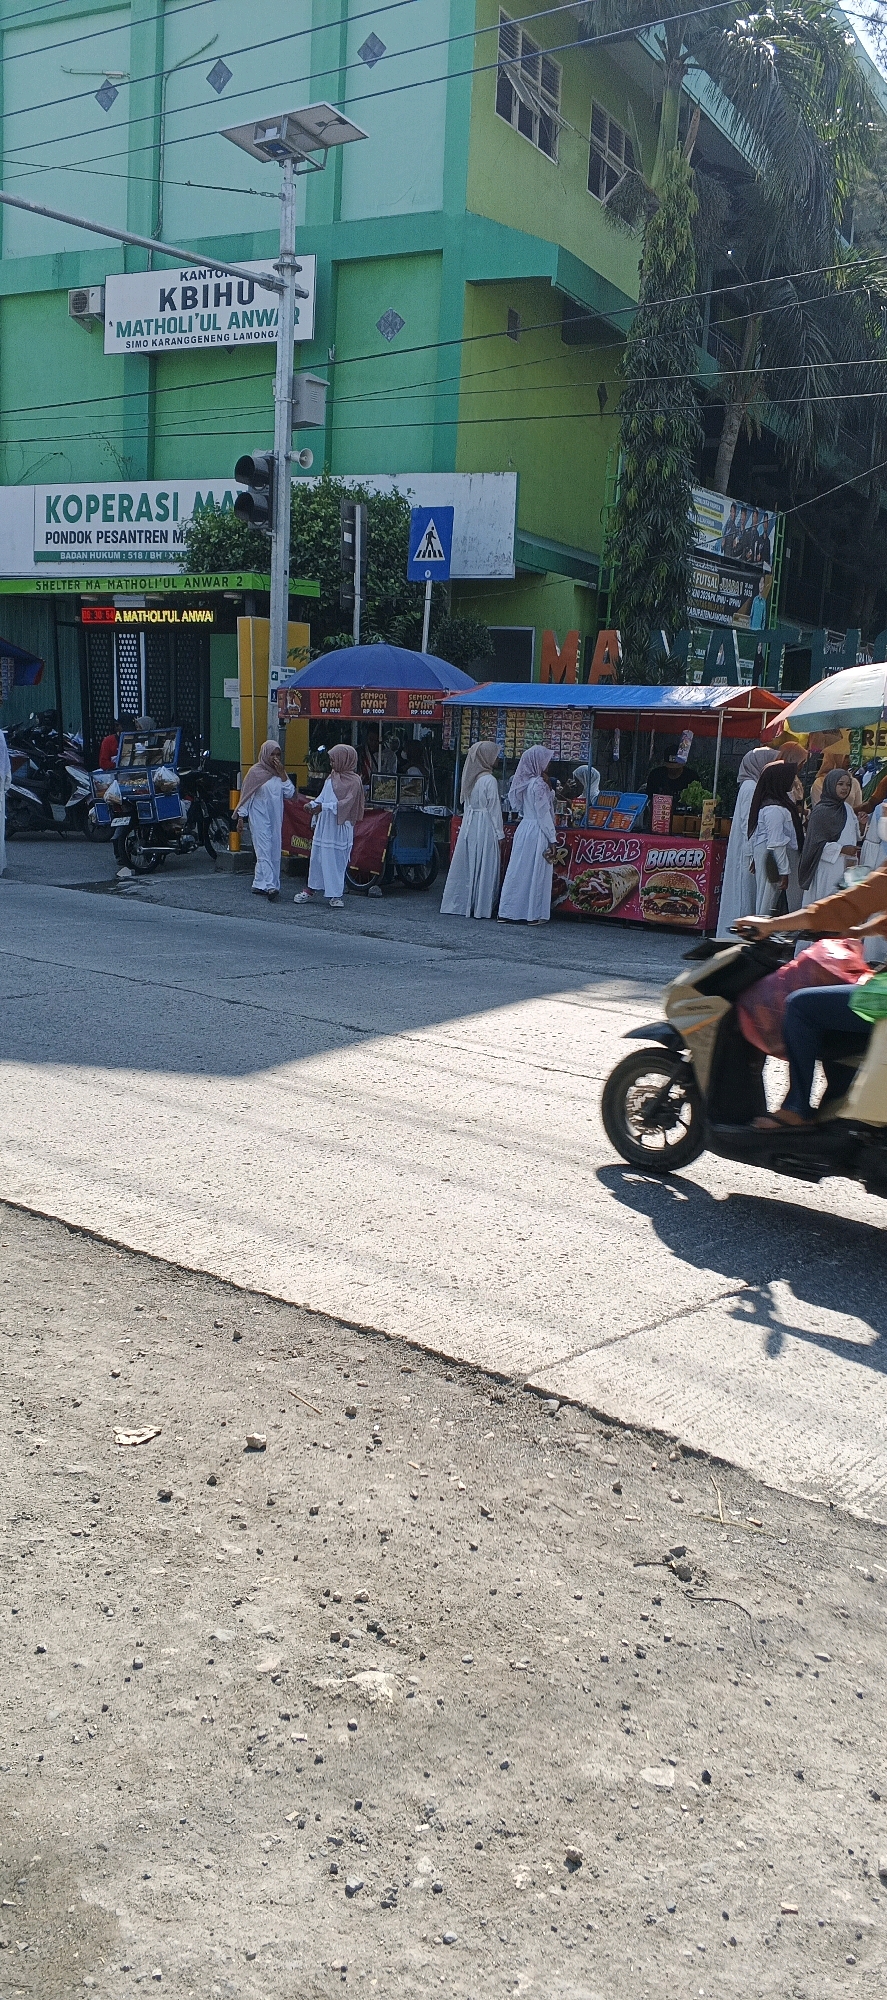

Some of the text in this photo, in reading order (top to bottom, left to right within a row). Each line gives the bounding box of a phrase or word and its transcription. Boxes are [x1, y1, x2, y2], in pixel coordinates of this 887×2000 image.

[180, 269, 232, 282] KANTO
[159, 280, 255, 312] KBIHU
[116, 312, 222, 338] MATHOLI'UL
[125, 339, 149, 349] SIMO
[151, 333, 230, 347] KARANGGENENG
[45, 492, 179, 523] KOPERASI
[45, 530, 92, 545] PONDOK
[96, 529, 168, 544] PESANTREN
[60, 552, 89, 560] BADAN
[89, 551, 121, 560] HUKUM
[127, 551, 144, 560] 518
[35, 576, 243, 591] SHELTER MA MATHOLI'UL ANWAR 2
[539, 630, 622, 684] MA
[319, 699, 342, 708] AYAM
[360, 699, 387, 709] AYAM
[574, 838, 641, 864] KEBAB
[644, 848, 706, 874] BURGER
